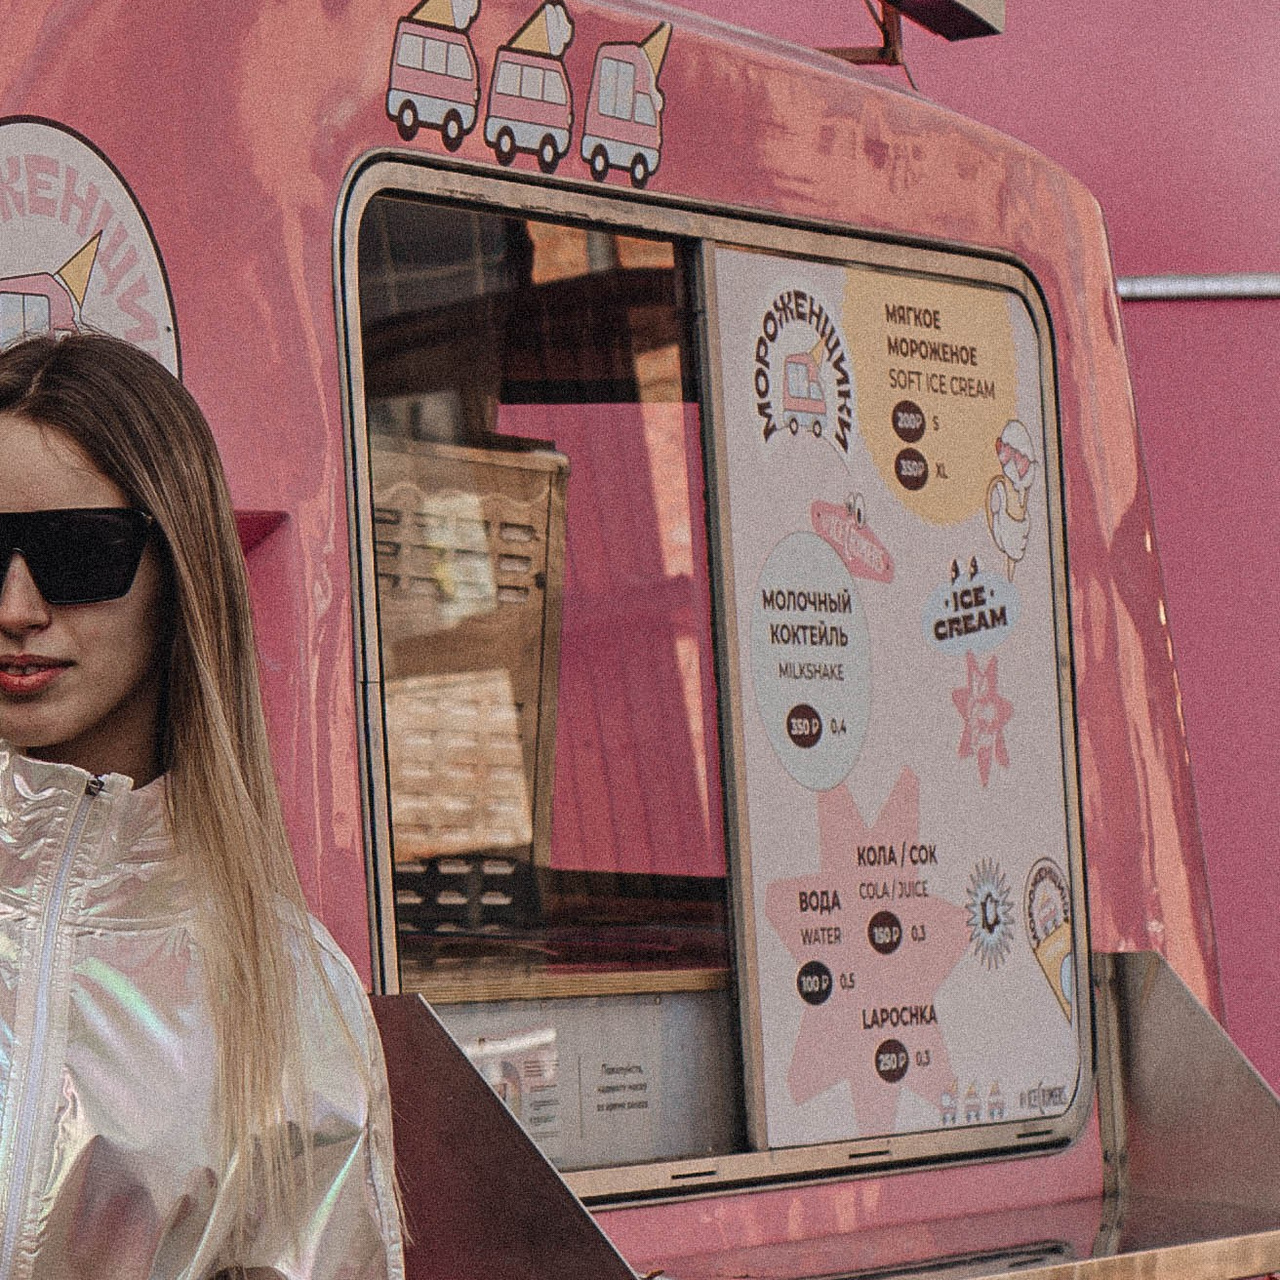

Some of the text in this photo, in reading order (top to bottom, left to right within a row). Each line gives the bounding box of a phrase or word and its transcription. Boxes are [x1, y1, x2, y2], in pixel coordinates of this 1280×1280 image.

[884, 303, 942, 330] МЯГКОЕ
[887, 335, 979, 367] МОРОЖЕНОЕ
[754, 288, 853, 454] МОРОЖЕНЩИКИ
[888, 368, 997, 401] SOFT ICE CREAM
[935, 461, 949, 480] XL
[761, 587, 853, 614] МОЛОЧНЫЙ
[951, 585, 988, 613] ICE
[769, 620, 850, 648] КОКТЕЙЛЬ
[933, 605, 1009, 642] CREAM
[777, 661, 845, 682] MILKSHAKE
[857, 844, 898, 867] КОЛА
[909, 843, 939, 866] СОК
[798, 889, 842, 916] ВОДА
[800, 926, 842, 946] WATER
[861, 1003, 939, 1031] LAPOCHKA
